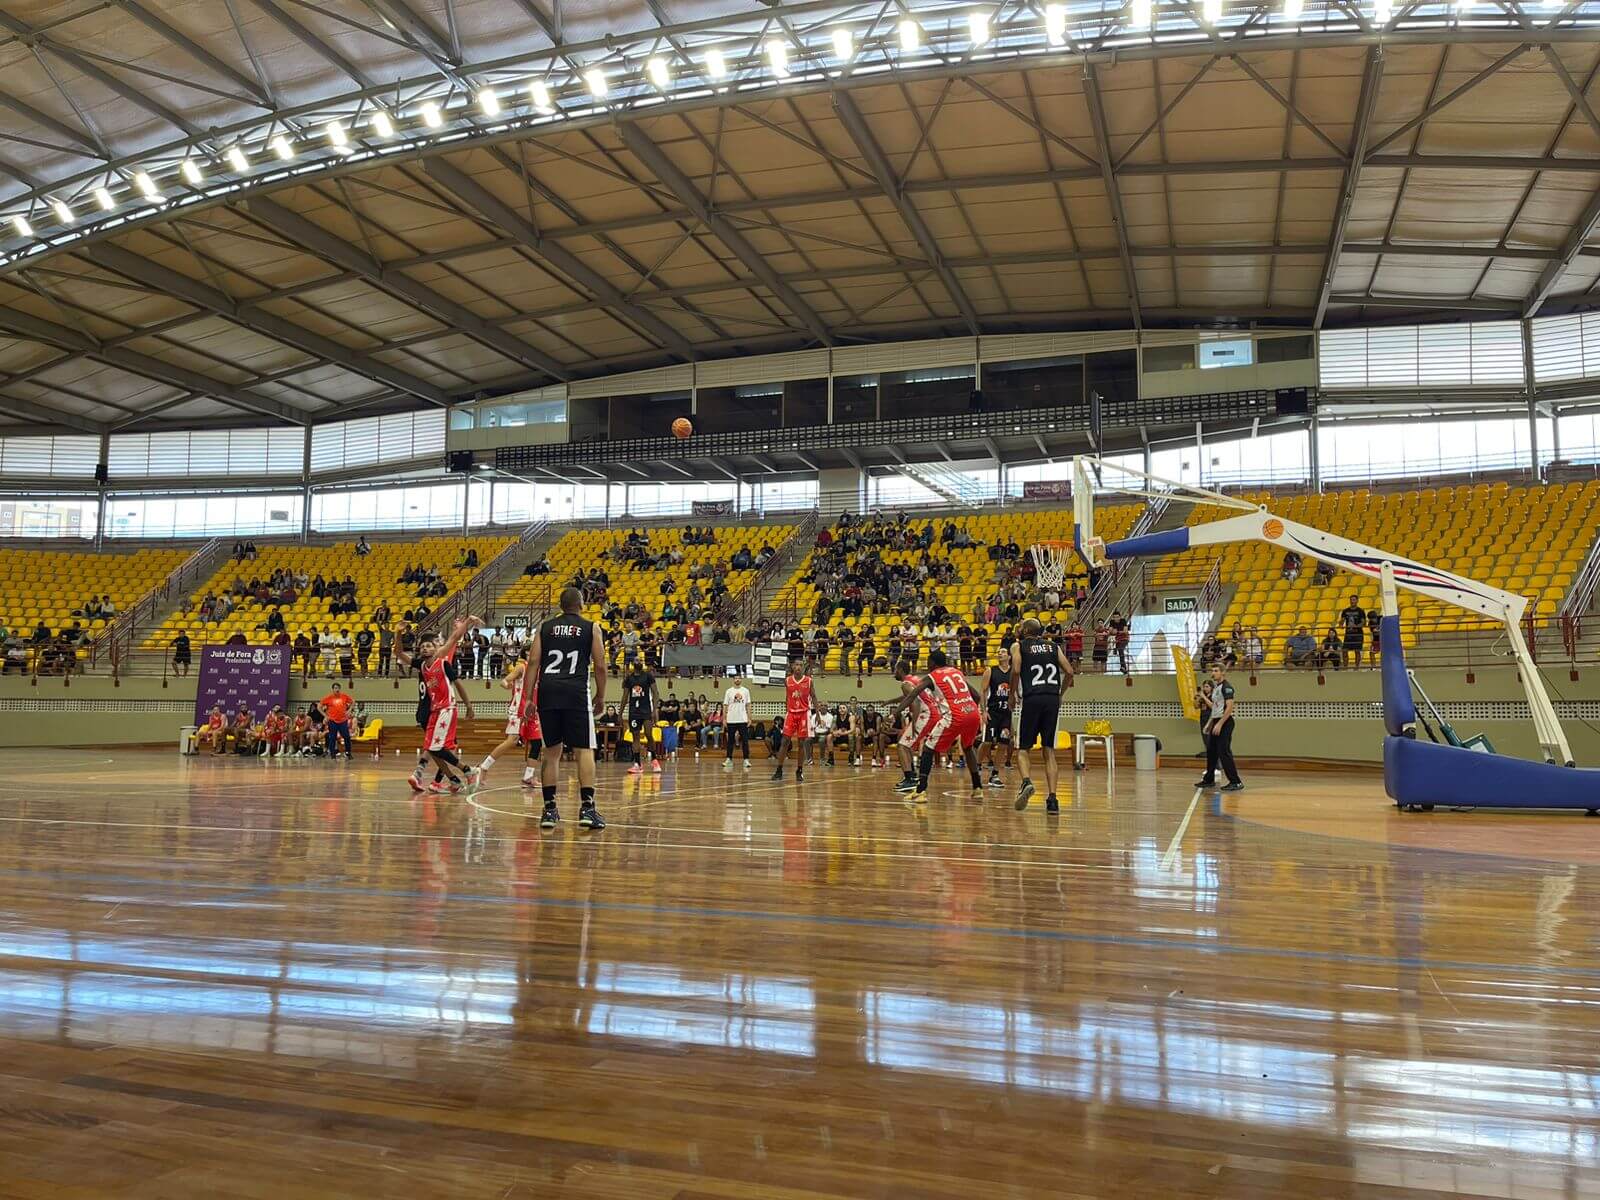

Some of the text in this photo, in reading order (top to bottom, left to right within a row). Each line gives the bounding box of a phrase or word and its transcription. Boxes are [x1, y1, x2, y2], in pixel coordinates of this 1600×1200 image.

[1167, 600, 1194, 611] SAÍDA
[226, 650, 236, 658] de
[236, 650, 252, 658] Fora
[544, 649, 579, 674] 21
[943, 673, 969, 694] 13
[1030, 663, 1058, 686] 22
[419, 682, 427, 700] 9
[999, 701, 1008, 709] 13
